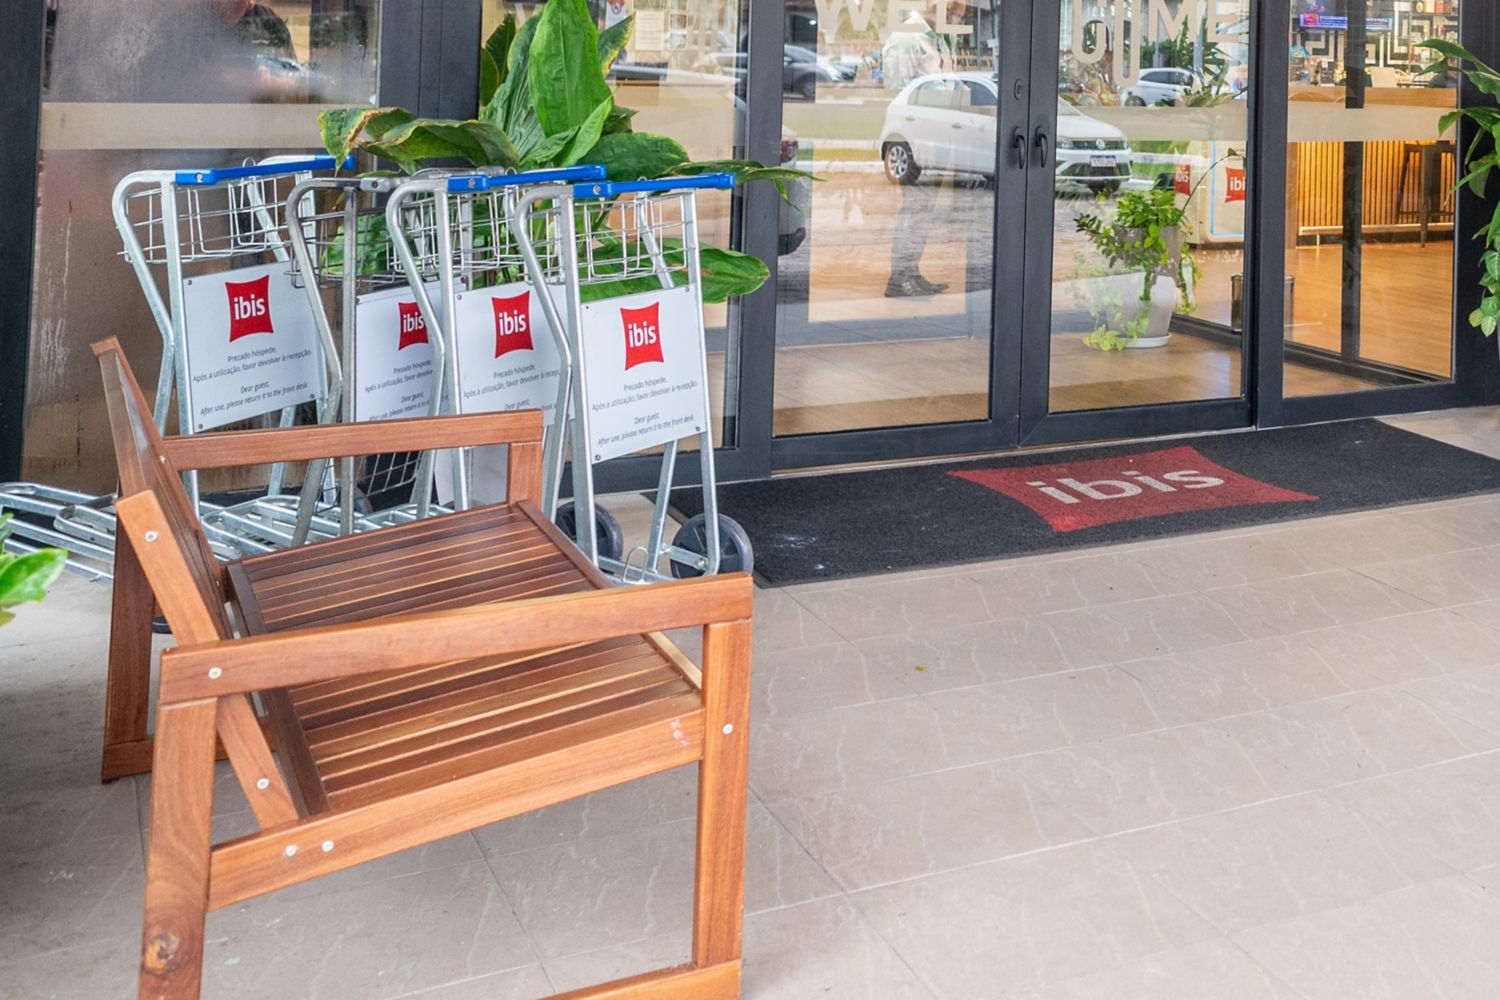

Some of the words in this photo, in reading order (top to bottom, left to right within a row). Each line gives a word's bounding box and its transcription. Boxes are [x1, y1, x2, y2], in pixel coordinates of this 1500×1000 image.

[1230, 176, 1246, 192] ibi
[234, 294, 266, 320] ibis
[403, 312, 424, 333] ibis
[499, 310, 526, 336] ibis
[628, 321, 656, 348] ibis
[1026, 470, 1224, 504] ibis
